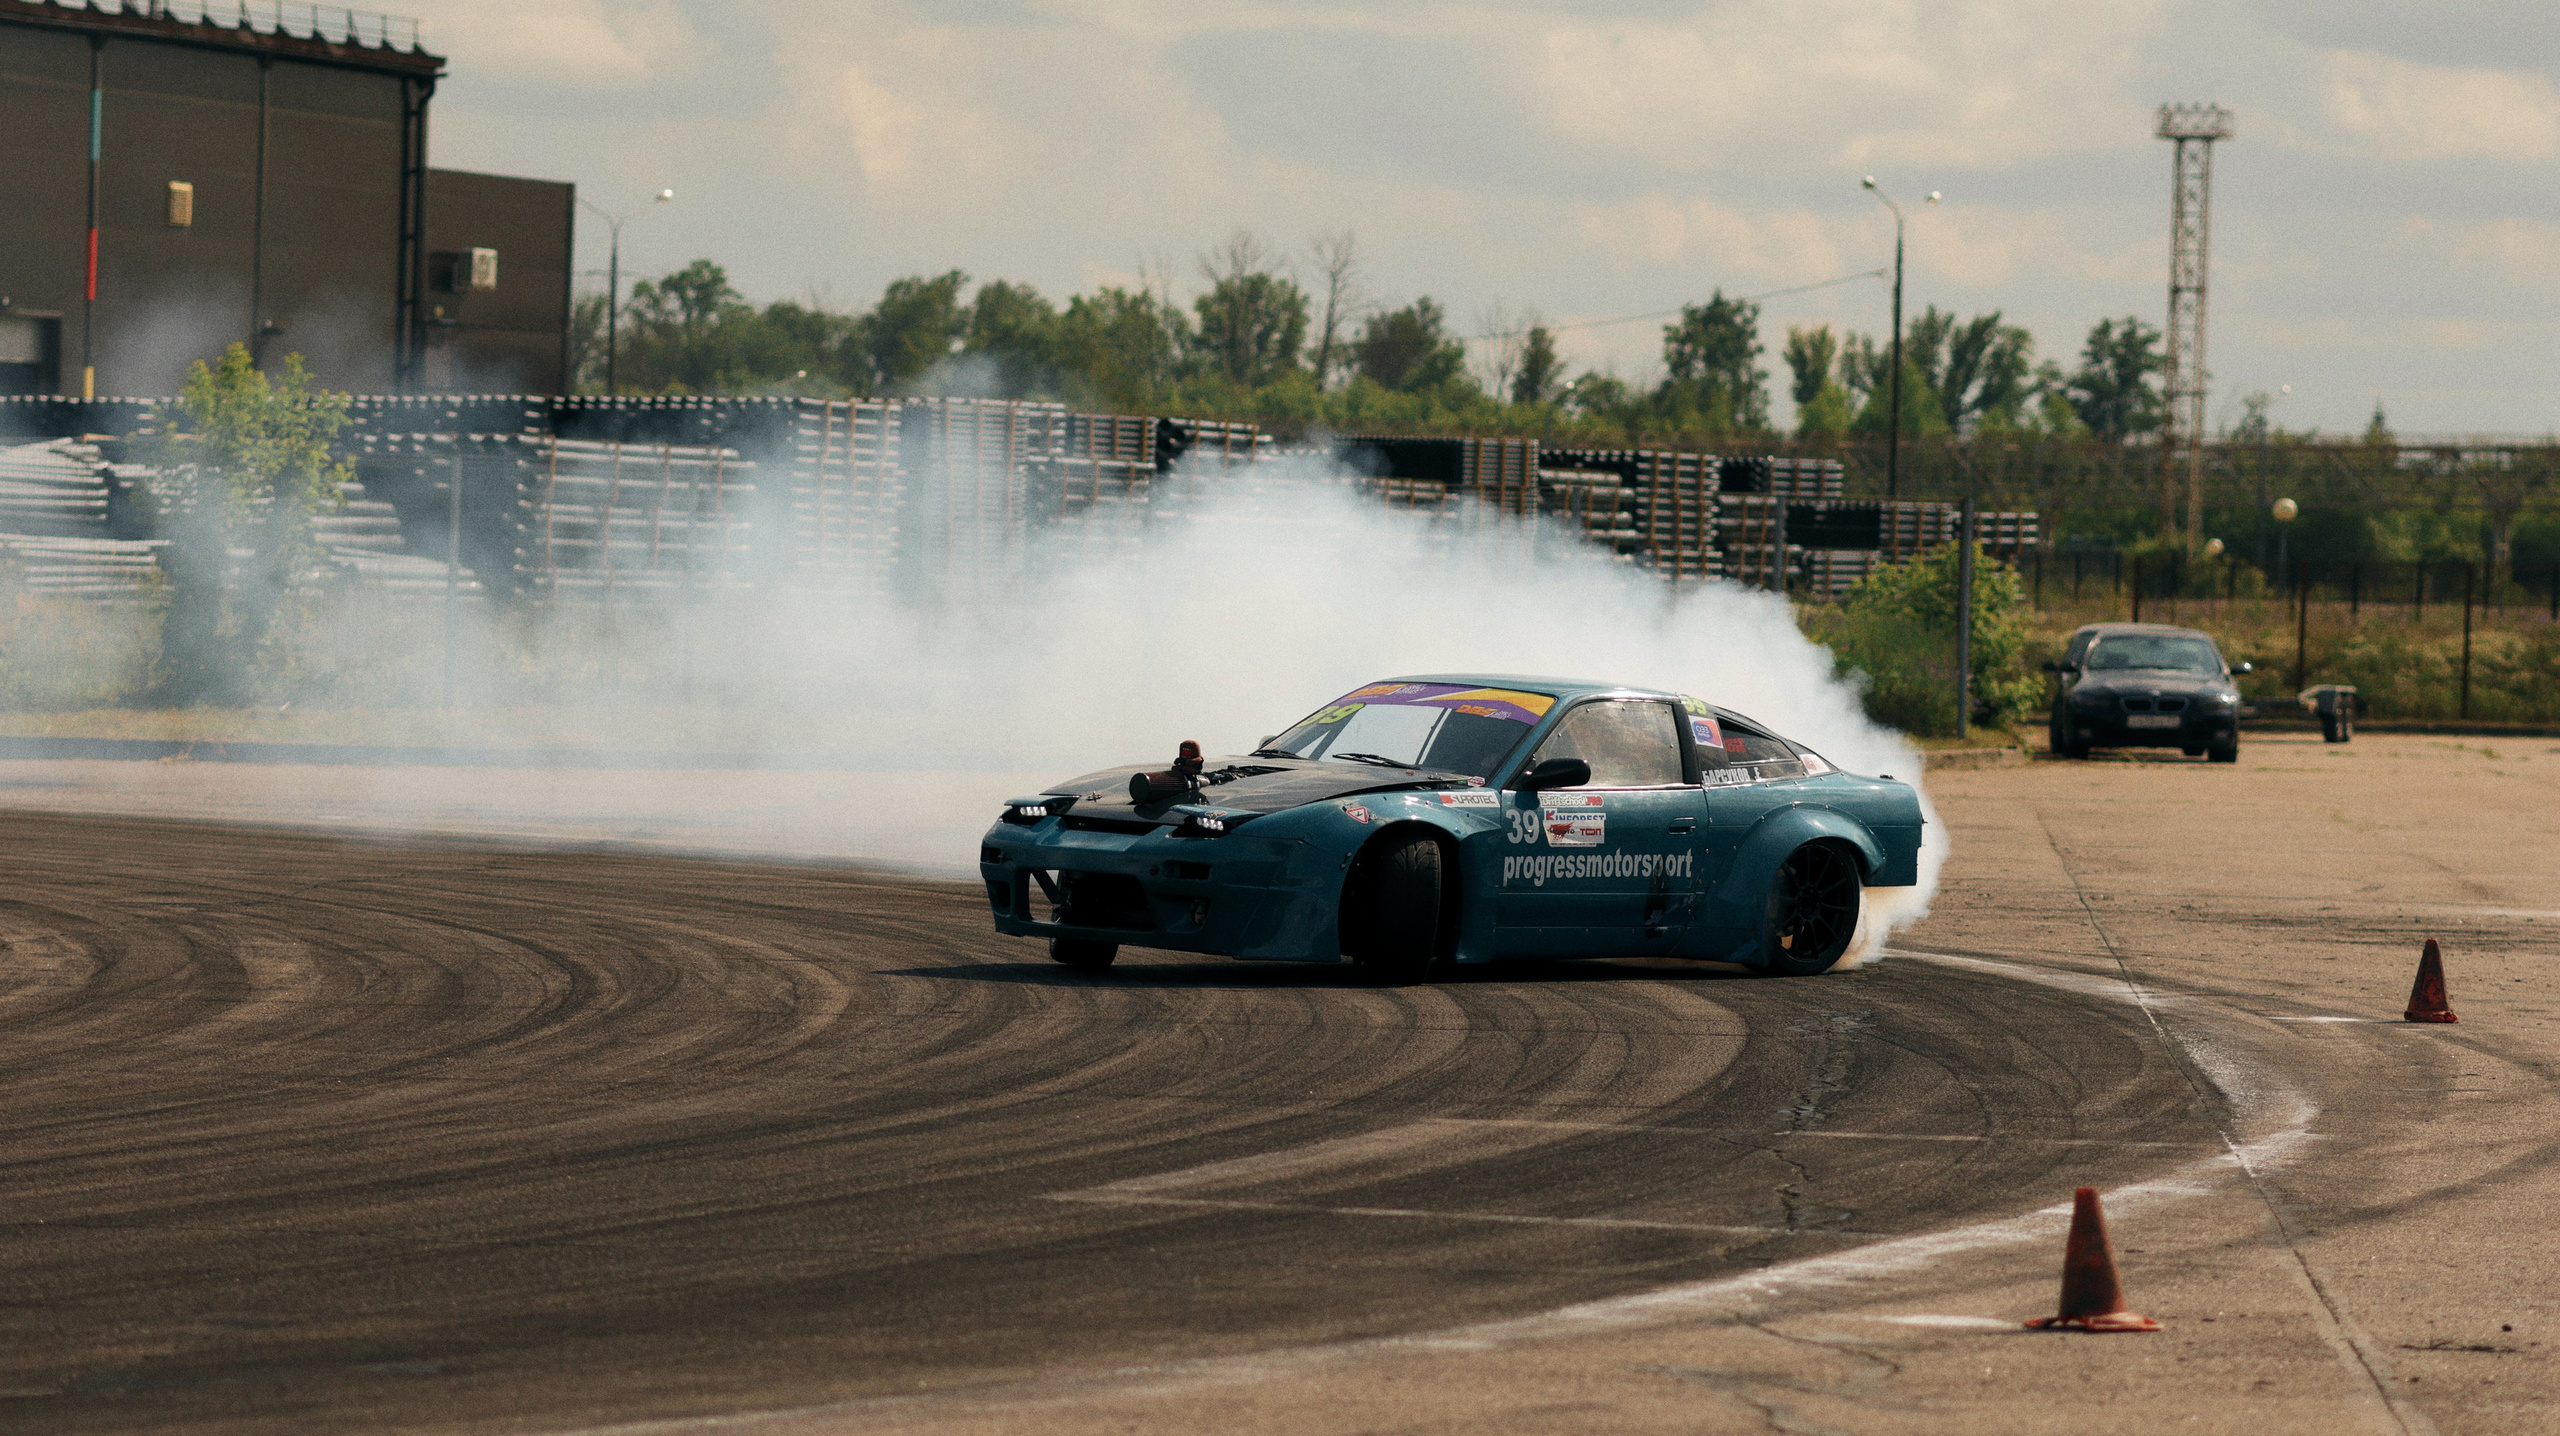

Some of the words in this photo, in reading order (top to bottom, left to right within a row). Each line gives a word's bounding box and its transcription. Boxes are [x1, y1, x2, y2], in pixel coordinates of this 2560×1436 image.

[1297, 702, 1366, 728] 39
[1682, 697, 1707, 714] 39
[1505, 809, 1540, 845] 39
[1503, 848, 1692, 887] progressmotorsport
